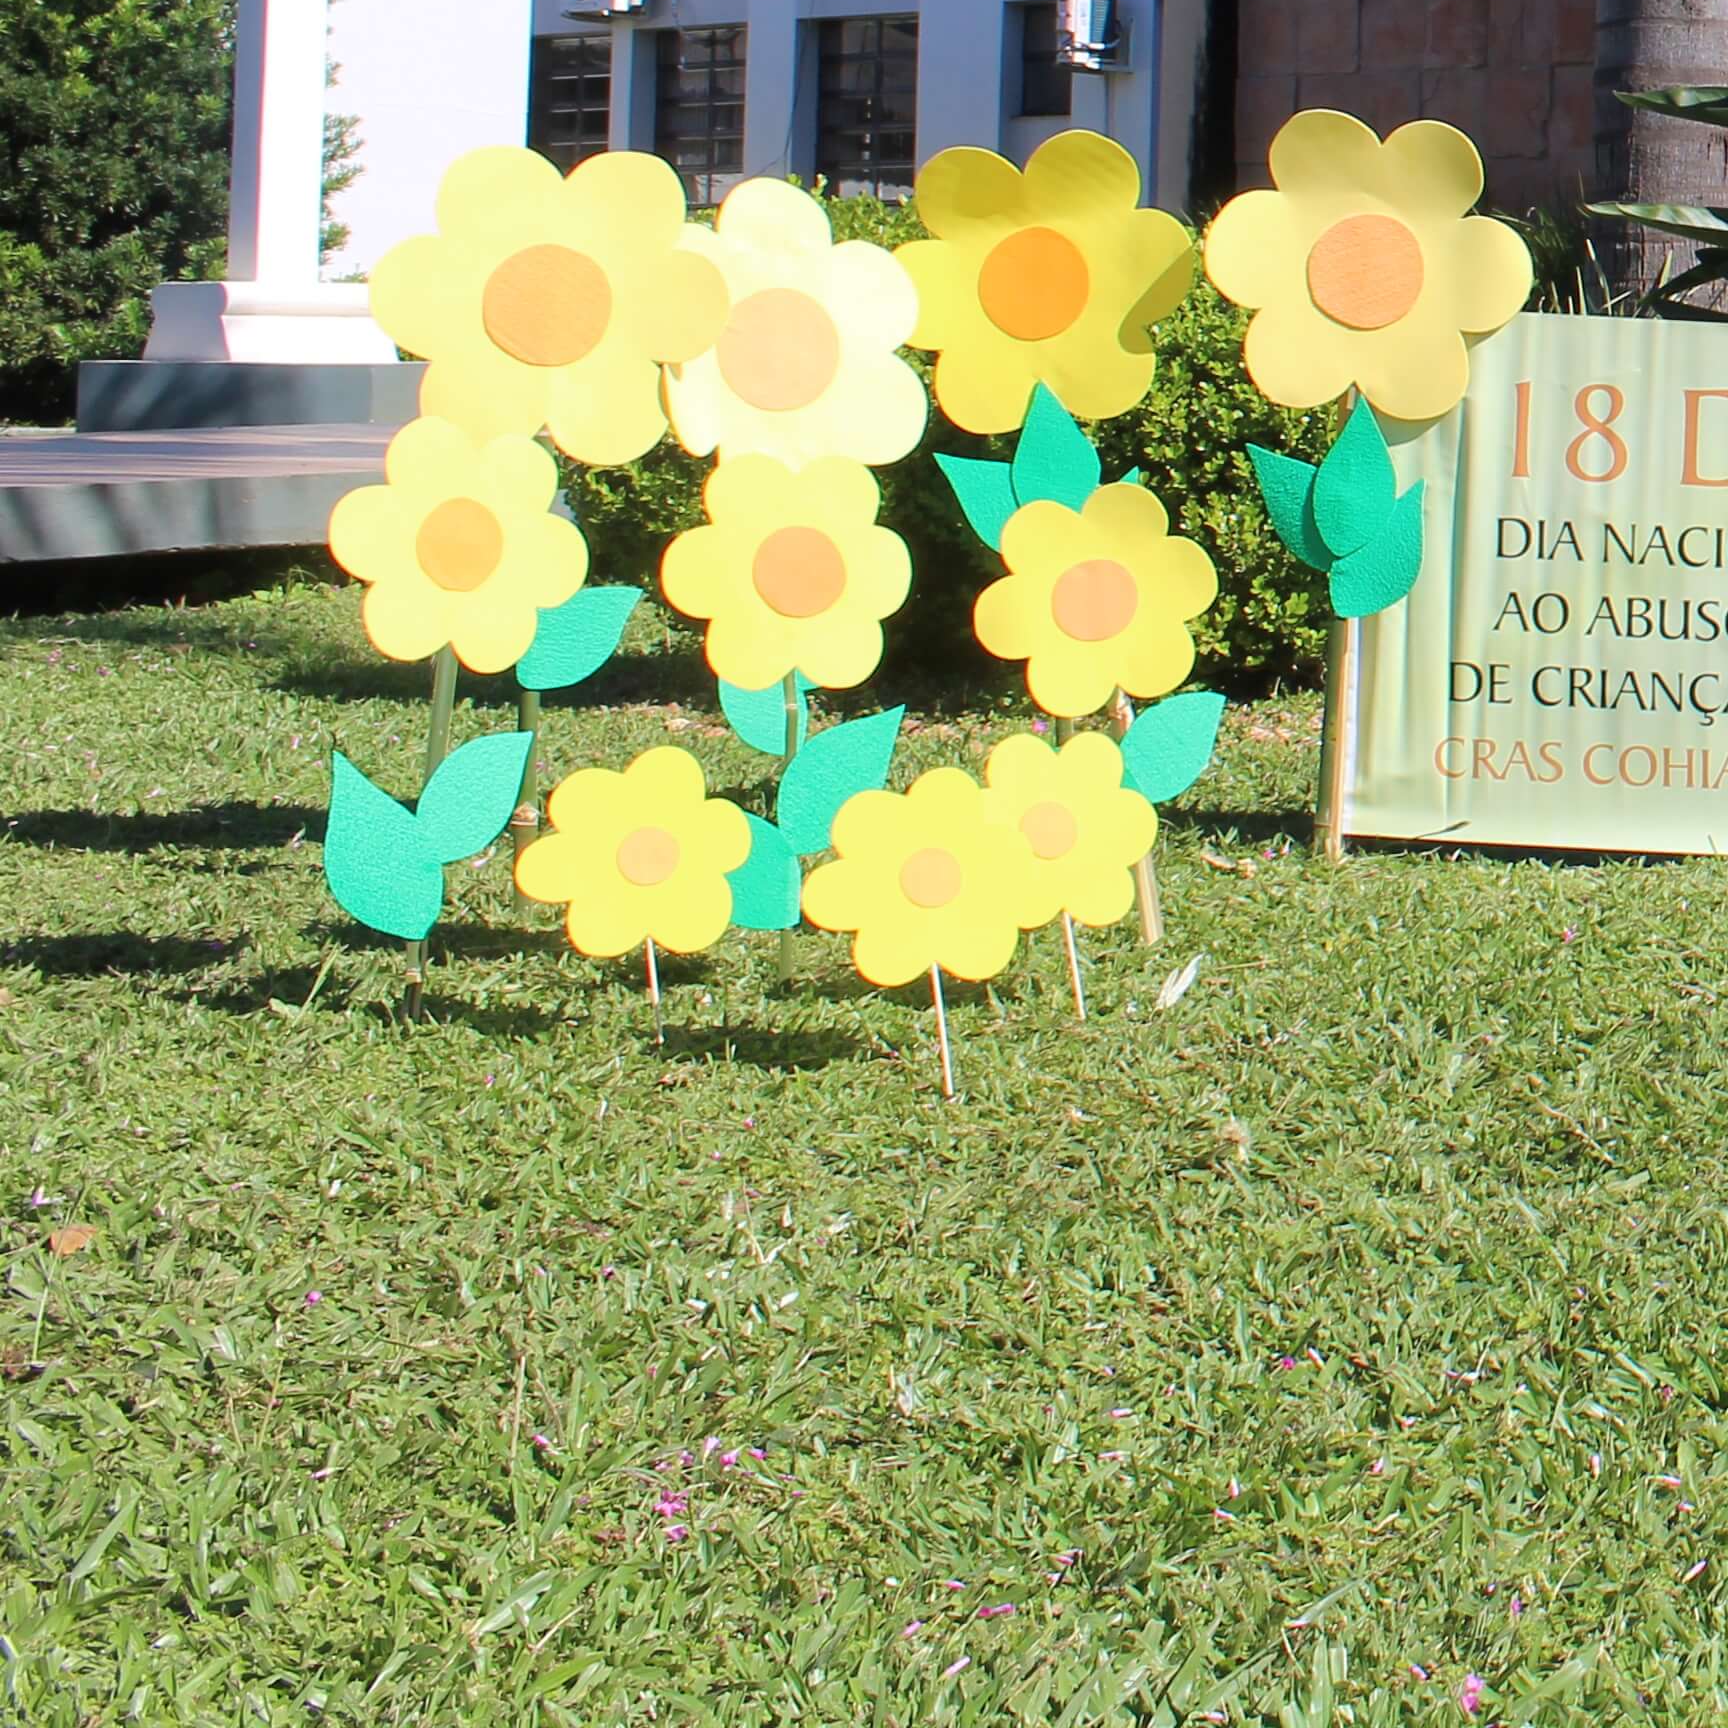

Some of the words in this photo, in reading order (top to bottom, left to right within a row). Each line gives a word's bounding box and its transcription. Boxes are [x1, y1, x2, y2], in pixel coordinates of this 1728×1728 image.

[1511, 379, 1630, 483] 18
[1495, 516, 1584, 565] DIA
[1493, 589, 1571, 634] AO
[1449, 660, 1513, 705] DE
[1434, 735, 1564, 785] CRAS
